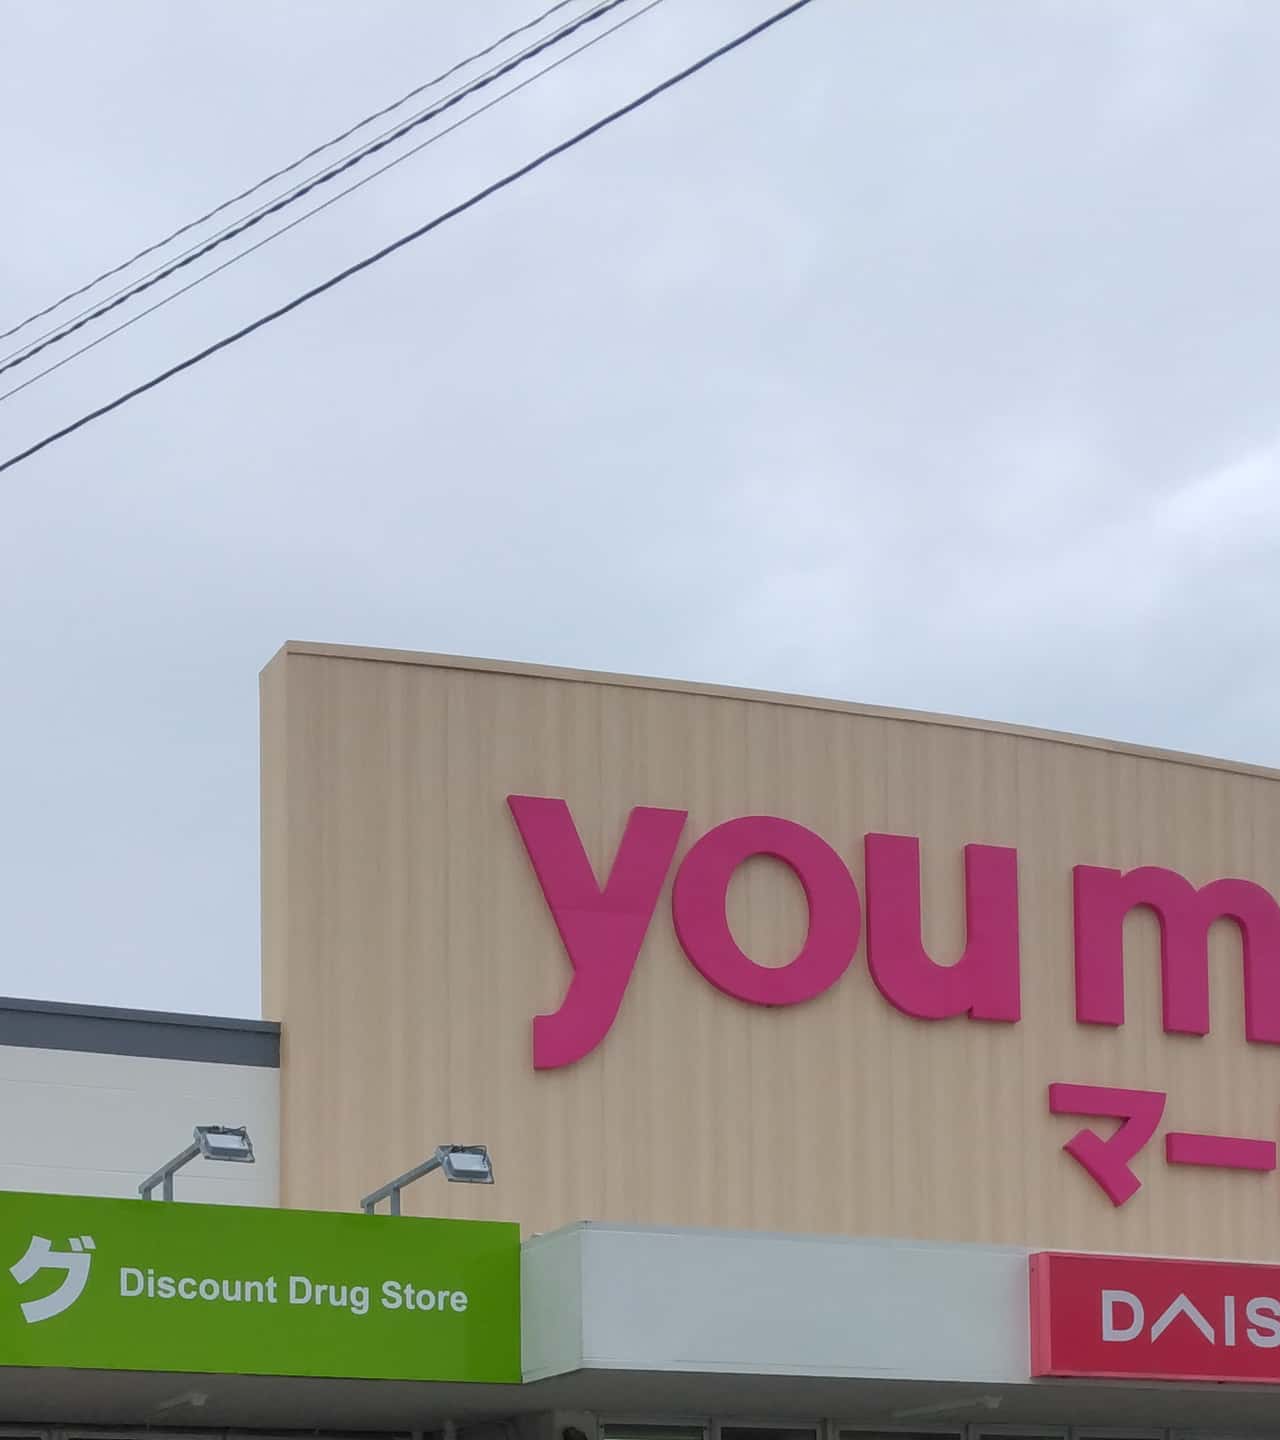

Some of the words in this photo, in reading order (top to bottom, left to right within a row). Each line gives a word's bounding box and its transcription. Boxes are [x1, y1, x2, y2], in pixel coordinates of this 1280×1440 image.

[119, 1266, 278, 1304] Discount
[288, 1275, 370, 1316] Drug
[381, 1279, 468, 1313] Store
